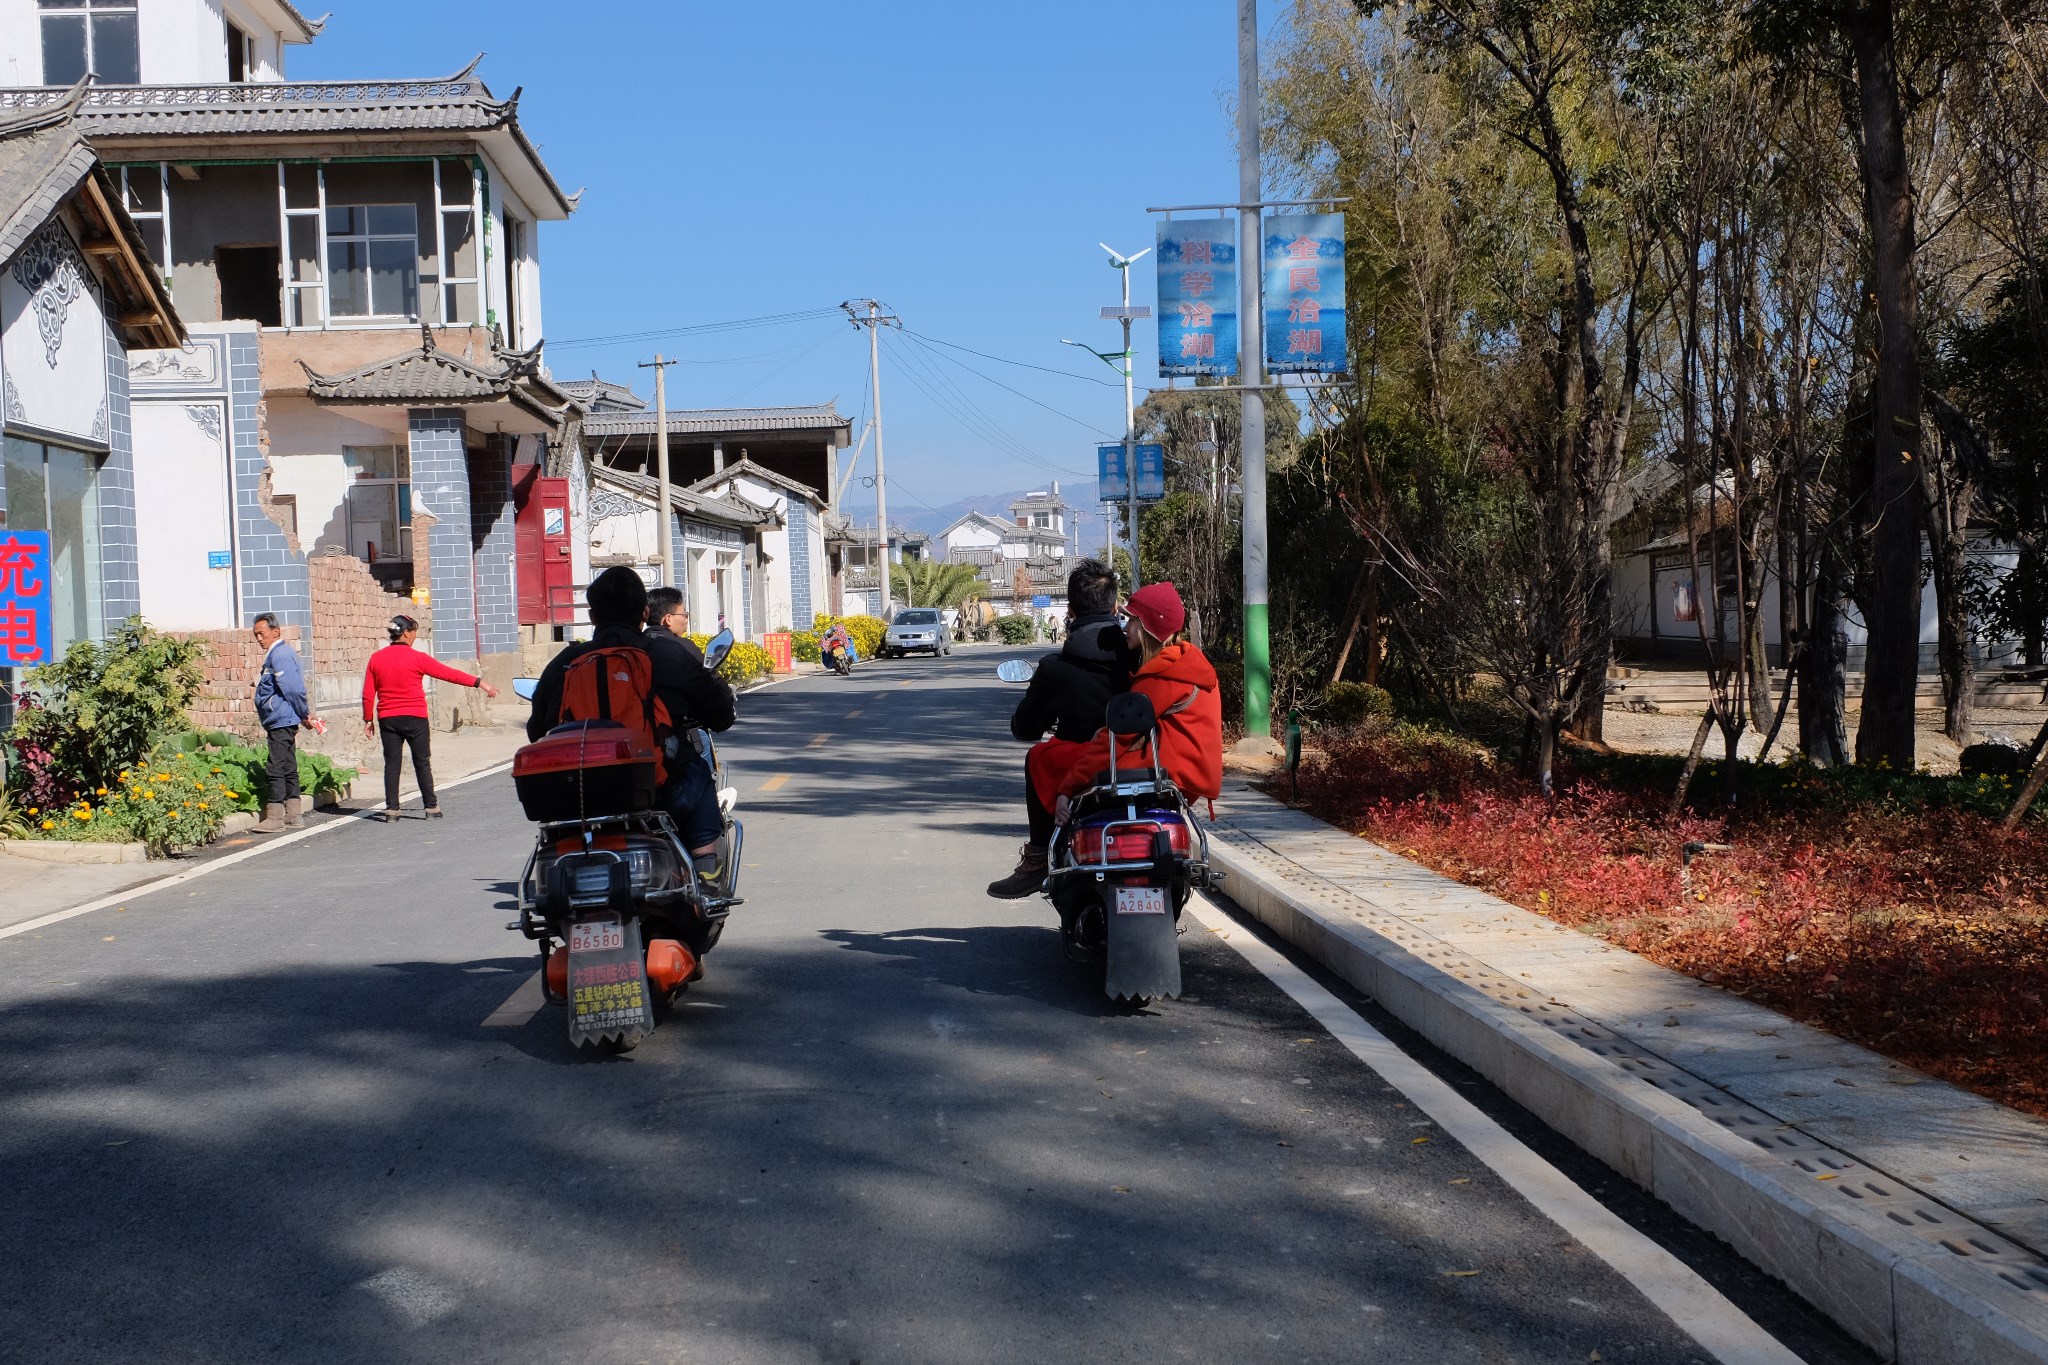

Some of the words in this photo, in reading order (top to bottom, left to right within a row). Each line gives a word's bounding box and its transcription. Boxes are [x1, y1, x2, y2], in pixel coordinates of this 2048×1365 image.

[1179, 240, 1215, 358] 科学治湖
[1287, 236, 1322, 354] 全民治湖
[0, 536, 44, 662] 充电
[573, 934, 620, 950] B6580
[1120, 900, 1161, 911] A2840
